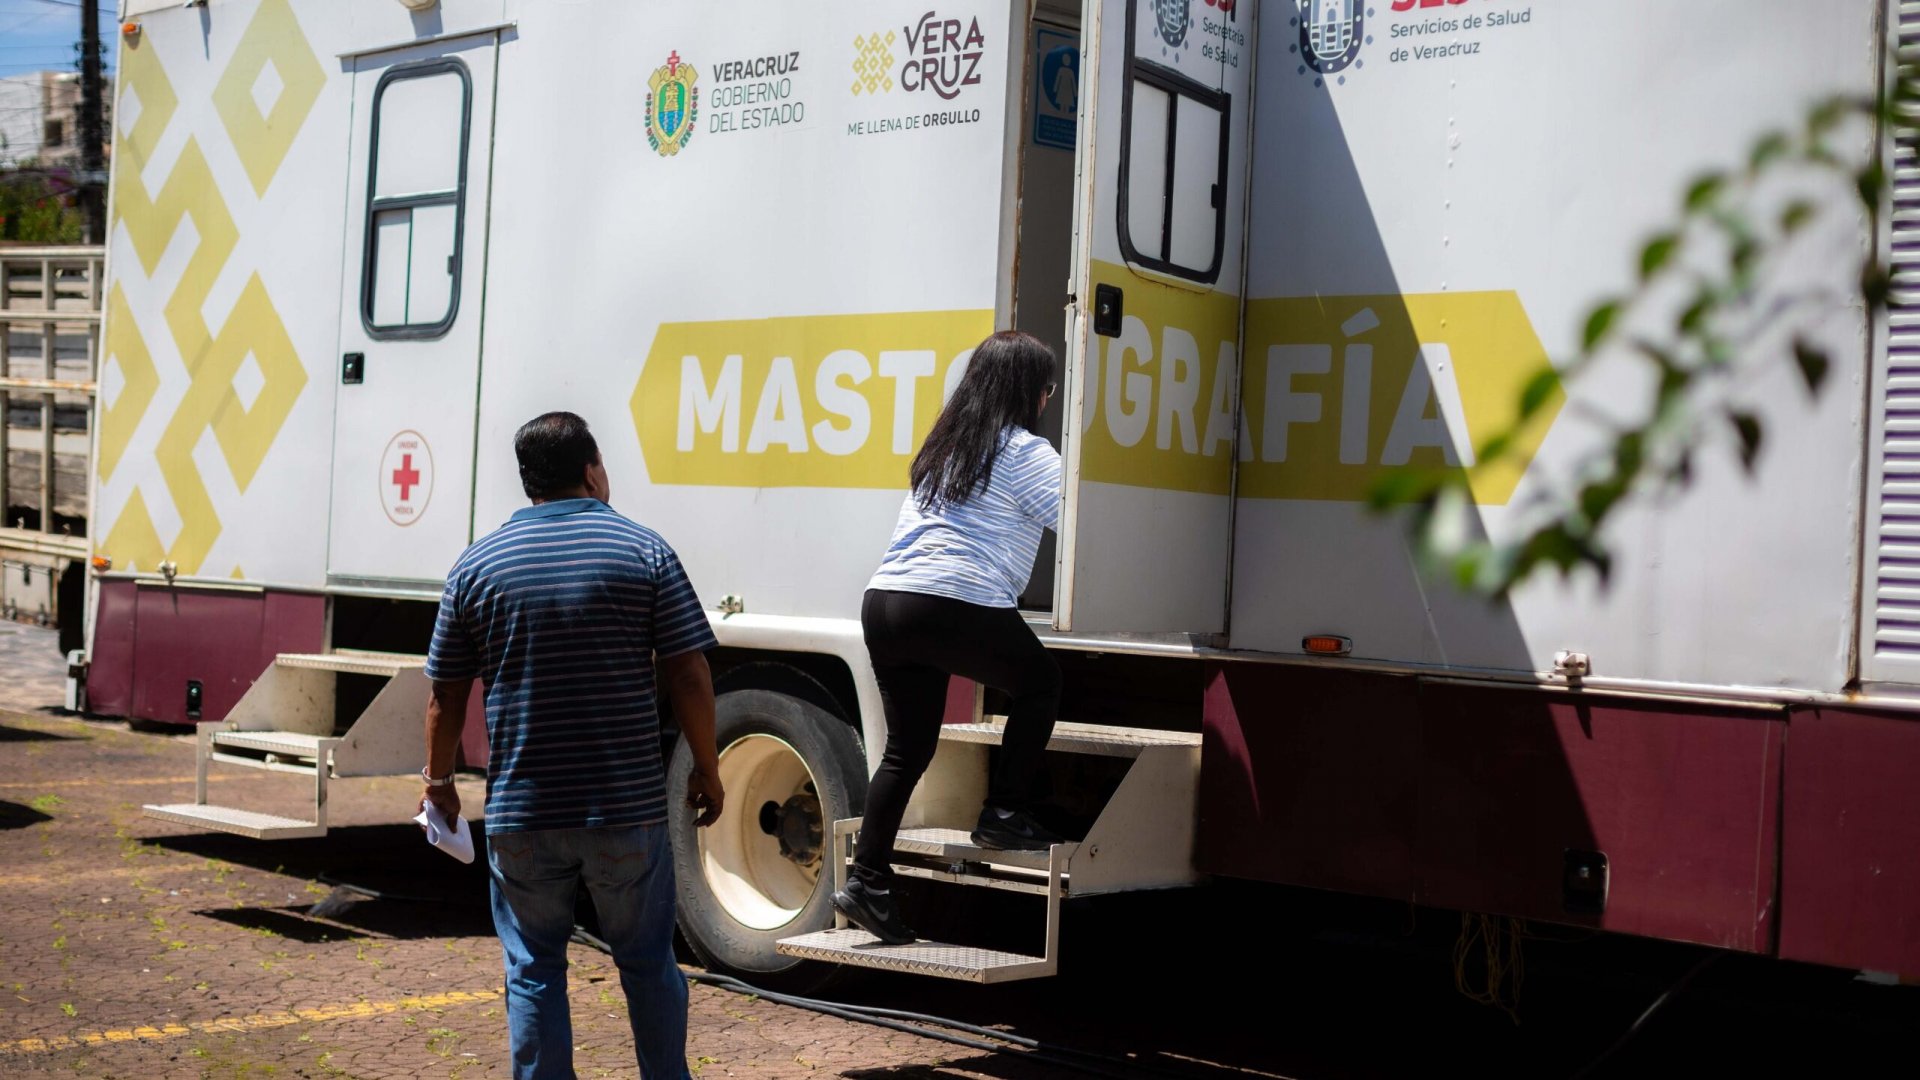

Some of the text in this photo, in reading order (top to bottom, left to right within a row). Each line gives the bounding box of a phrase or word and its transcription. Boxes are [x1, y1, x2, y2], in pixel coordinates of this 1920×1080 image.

[903, 10, 985, 56] VERA
[1390, 7, 1532, 39] Servicios de Salud
[713, 51, 800, 83] VERACRUZ
[1202, 41, 1238, 68] de Salud
[1390, 41, 1480, 63] de Veracruz
[901, 51, 984, 100] CRUZ
[711, 77, 791, 109] GOBIERNO
[709, 102, 804, 134] DEL ESTADO
[847, 108, 981, 136] ME LLENA DE ORGULLO
